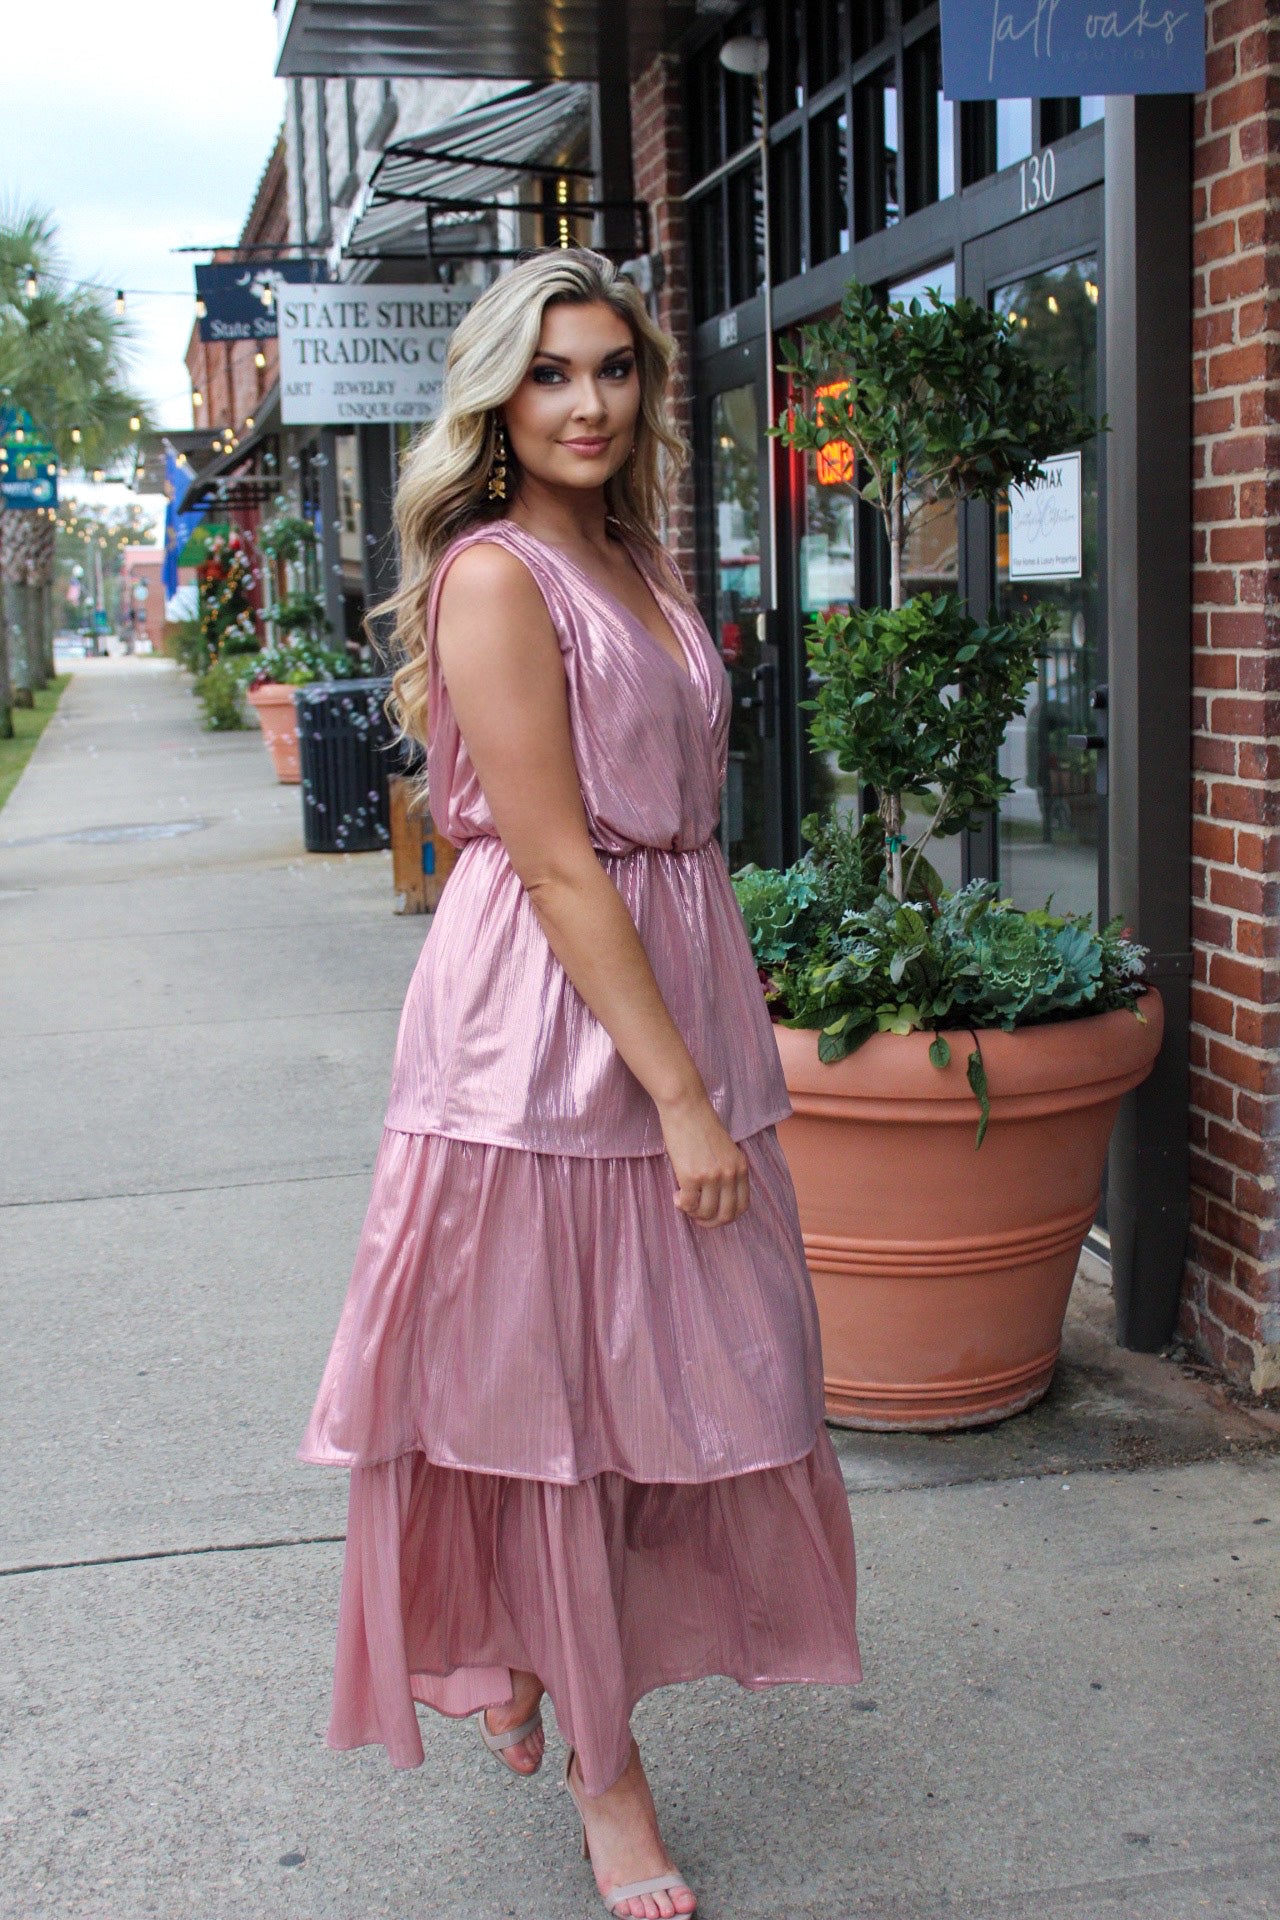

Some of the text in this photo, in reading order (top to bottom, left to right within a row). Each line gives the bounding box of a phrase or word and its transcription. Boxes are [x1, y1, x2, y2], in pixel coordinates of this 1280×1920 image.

[1019, 149, 1056, 214] 130
[284, 301, 474, 328] STATE STREE
[292, 337, 419, 365] TRADING
[286, 381, 312, 396] ART
[333, 381, 395, 396] JEWELRY
[338, 402, 432, 419] UNIQUE GIFTS
